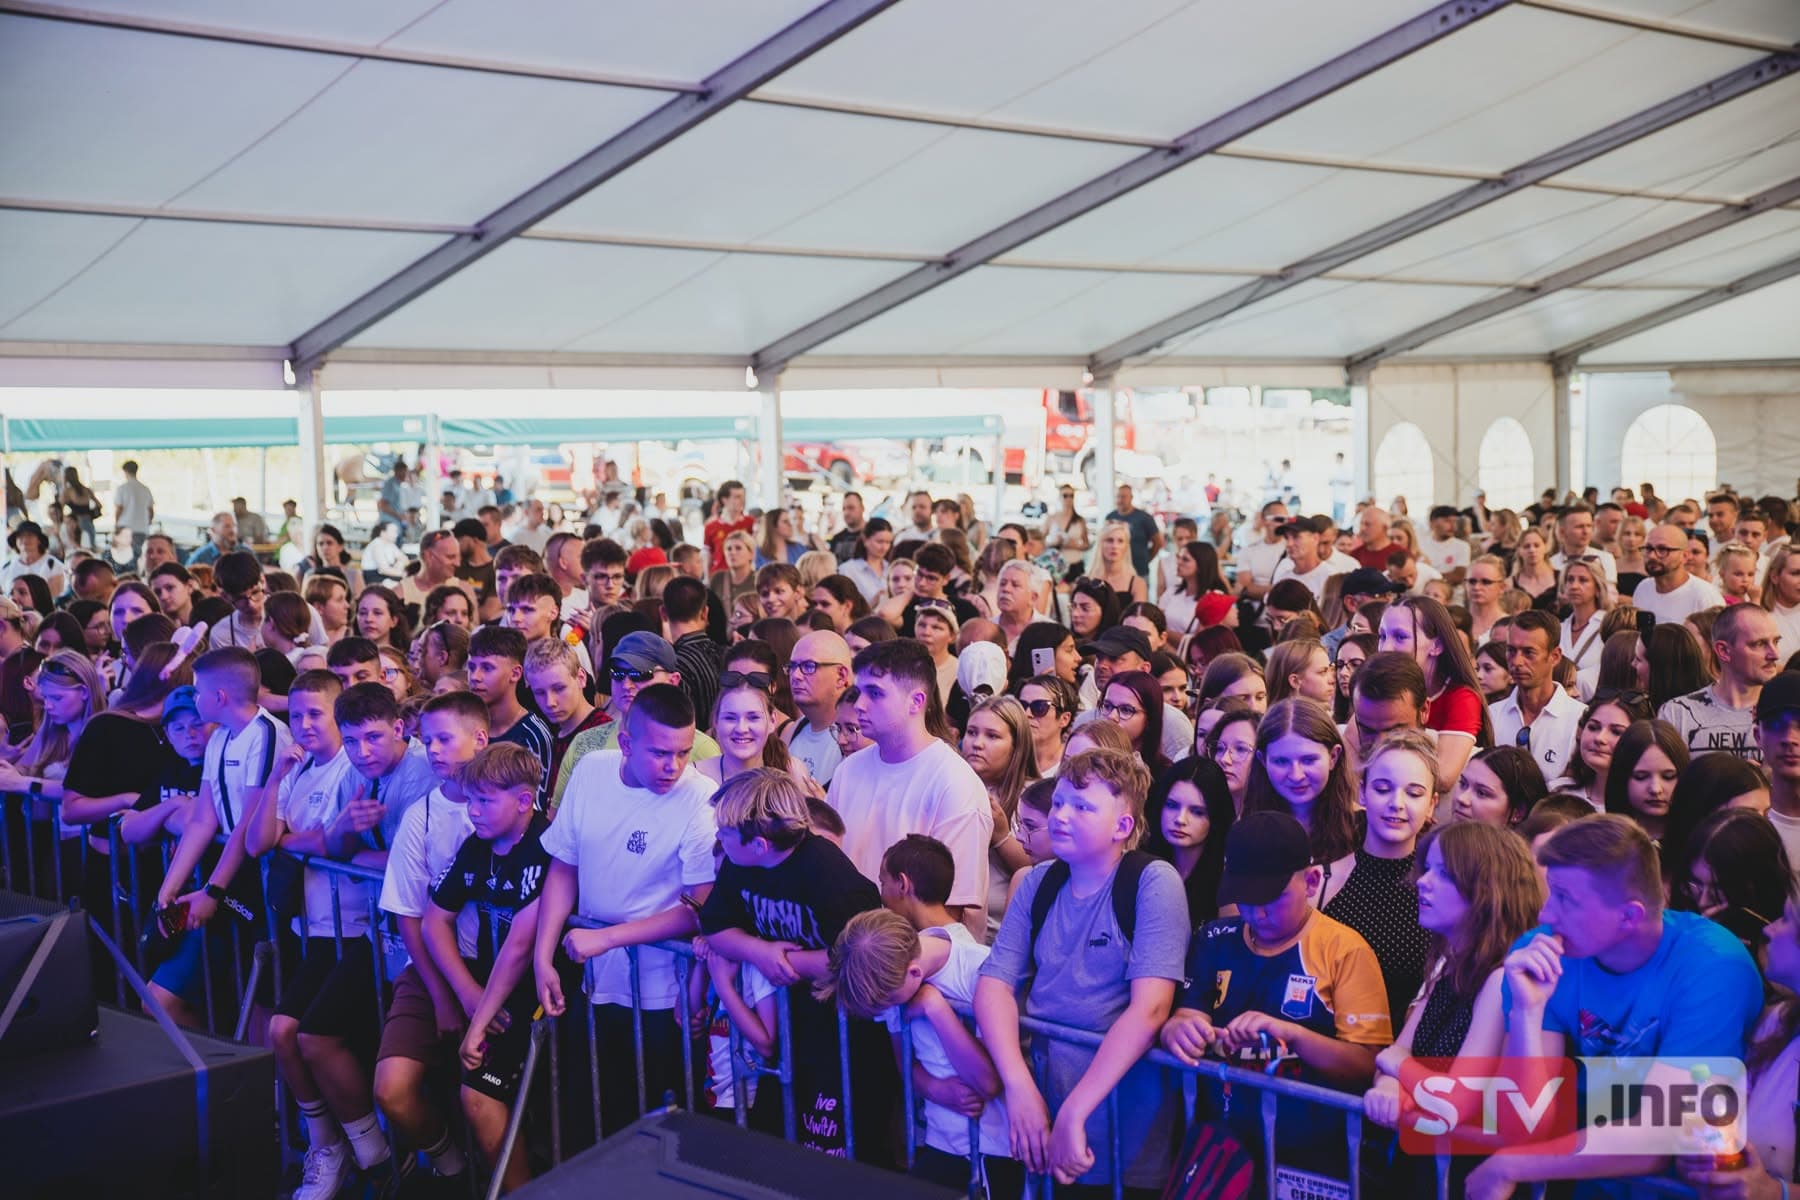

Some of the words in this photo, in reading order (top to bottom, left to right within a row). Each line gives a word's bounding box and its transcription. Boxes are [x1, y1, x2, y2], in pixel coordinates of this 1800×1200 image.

[1708, 732, 1746, 750] NEW
[1290, 976, 1313, 985] MZKS
[482, 1072, 502, 1086] JAKO
